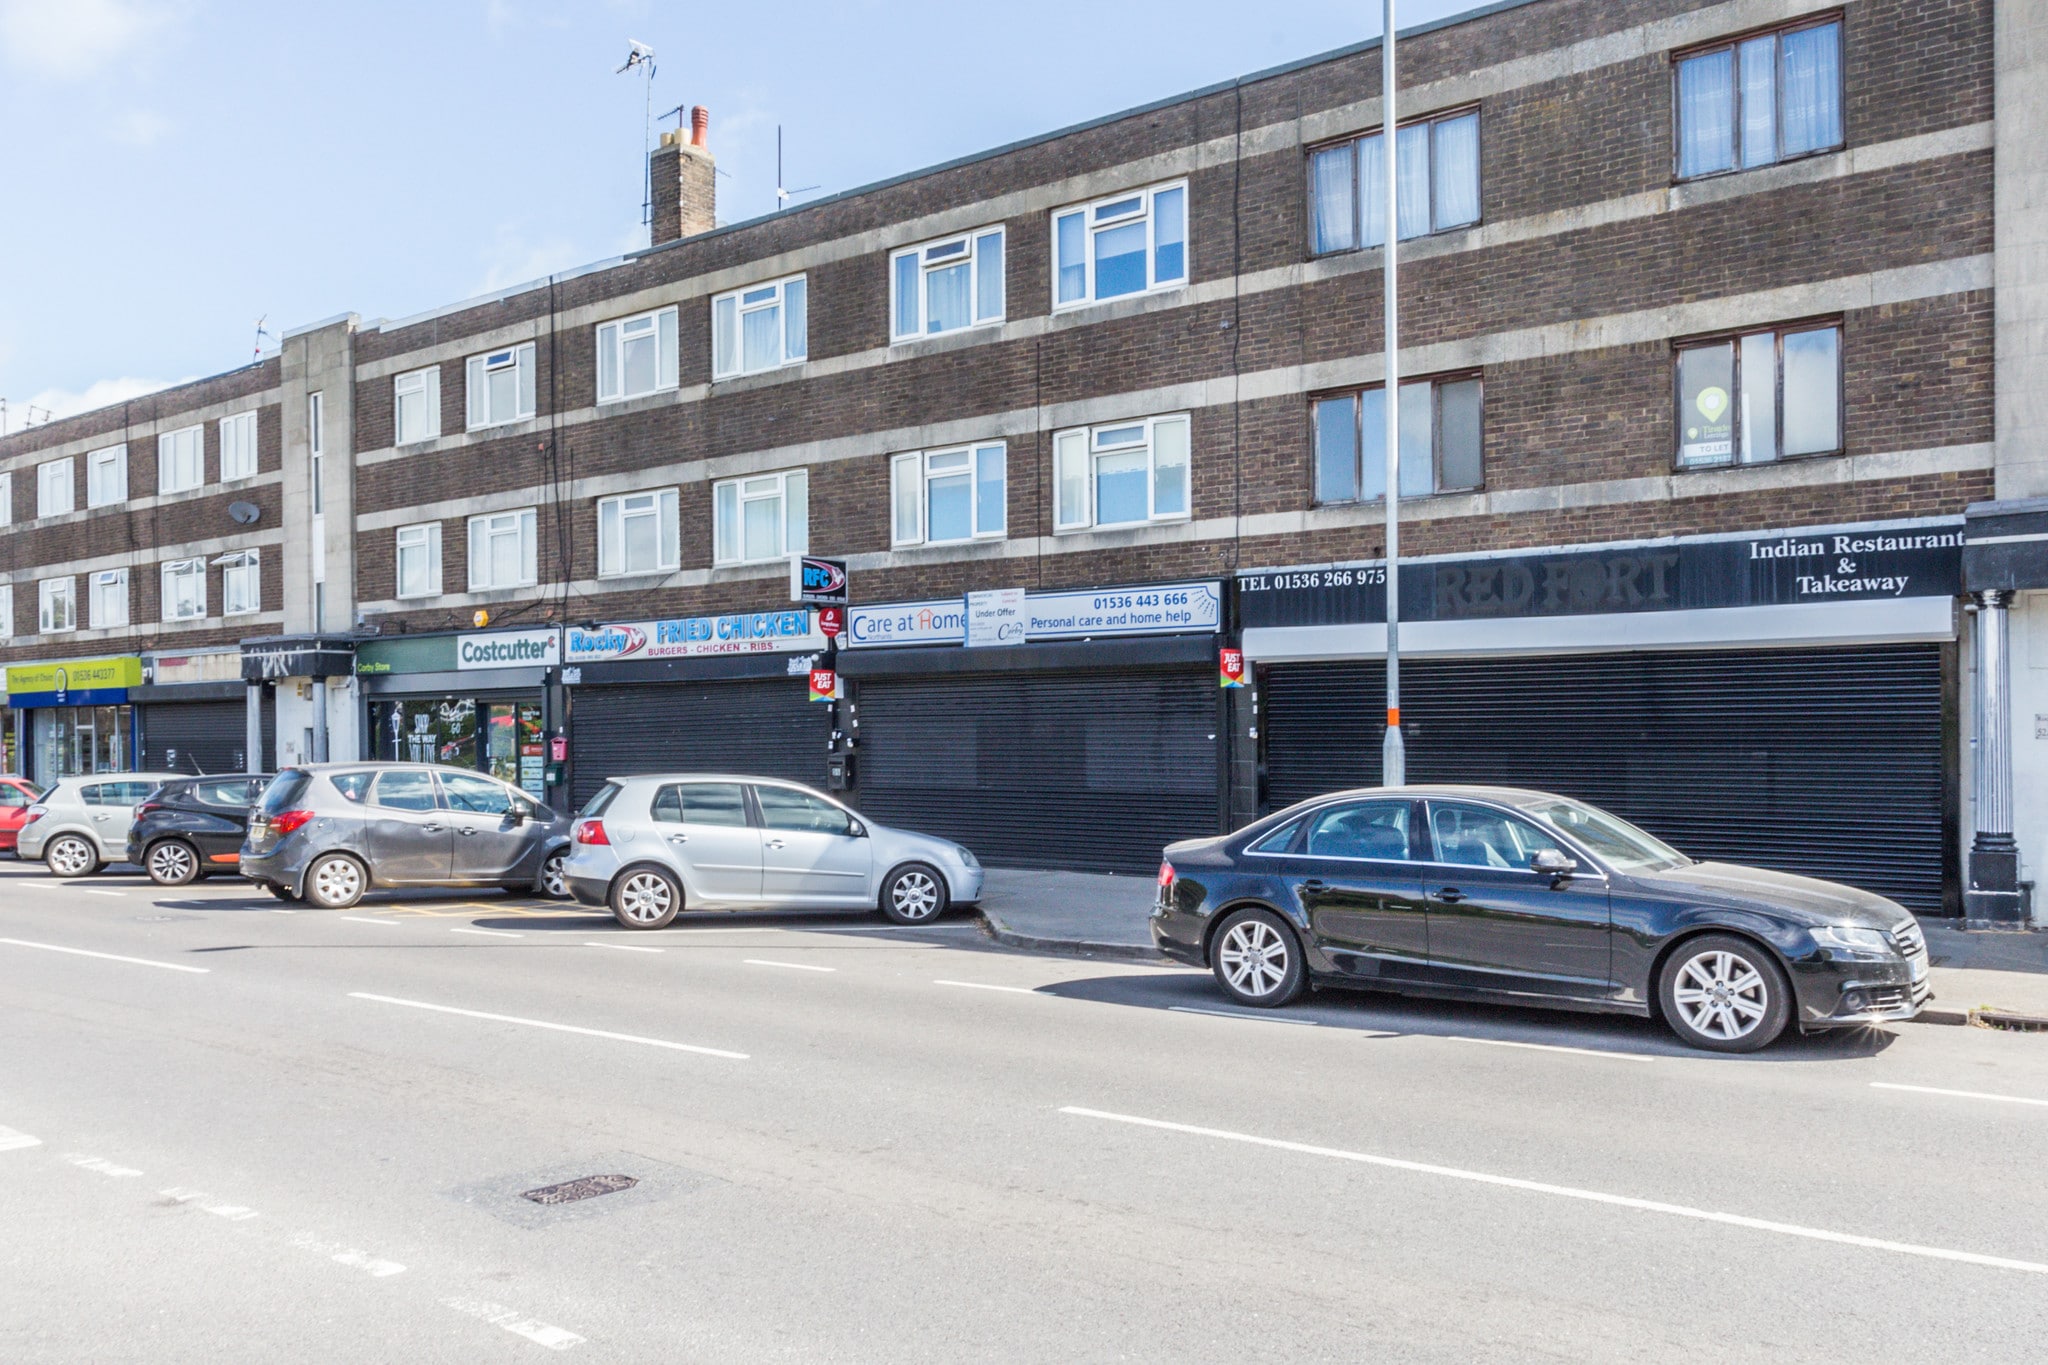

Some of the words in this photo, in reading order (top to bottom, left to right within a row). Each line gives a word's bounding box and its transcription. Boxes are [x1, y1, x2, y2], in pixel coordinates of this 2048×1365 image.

[1750, 539, 1825, 560] Indian
[1833, 531, 1966, 555] Restaurant
[1837, 557, 1857, 574] &
[803, 567, 829, 587] RFC
[1238, 575, 1271, 592] TEL
[1274, 573, 1319, 589] 01536
[1324, 571, 1352, 587] 266
[1356, 569, 1386, 585] 975
[1436, 564, 1535, 609] RED
[1541, 553, 1681, 607] FORT
[1796, 575, 1909, 596] Takeaway
[1094, 596, 1132, 610] 01536
[1136, 594, 1159, 607] 443
[1164, 592, 1188, 605] 666
[975, 610, 995, 618] Under
[997, 607, 1016, 616] Offer
[1031, 616, 1075, 629] Personal
[1078, 615, 1103, 627] care
[1106, 612, 1127, 625] and
[1130, 611, 1162, 624] home
[1165, 609, 1192, 623] help
[656, 617, 712, 644] FRIED
[717, 610, 809, 640] CHICKEN
[853, 615, 892, 640] Care
[897, 614, 914, 631] at
[917, 608, 965, 630] Home
[462, 637, 548, 662] Costcutter
[570, 629, 626, 652] Rocky
[648, 646, 687, 656] BURGERS
[696, 643, 740, 653] CHICKEN
[750, 642, 773, 651] RIBS
[357, 663, 374, 673] Corby
[375, 662, 390, 671] Store
[1224, 653, 1241, 664] JUST
[1227, 663, 1241, 672] EAT
[813, 673, 832, 682] JUST
[817, 680, 832, 689] EAT
